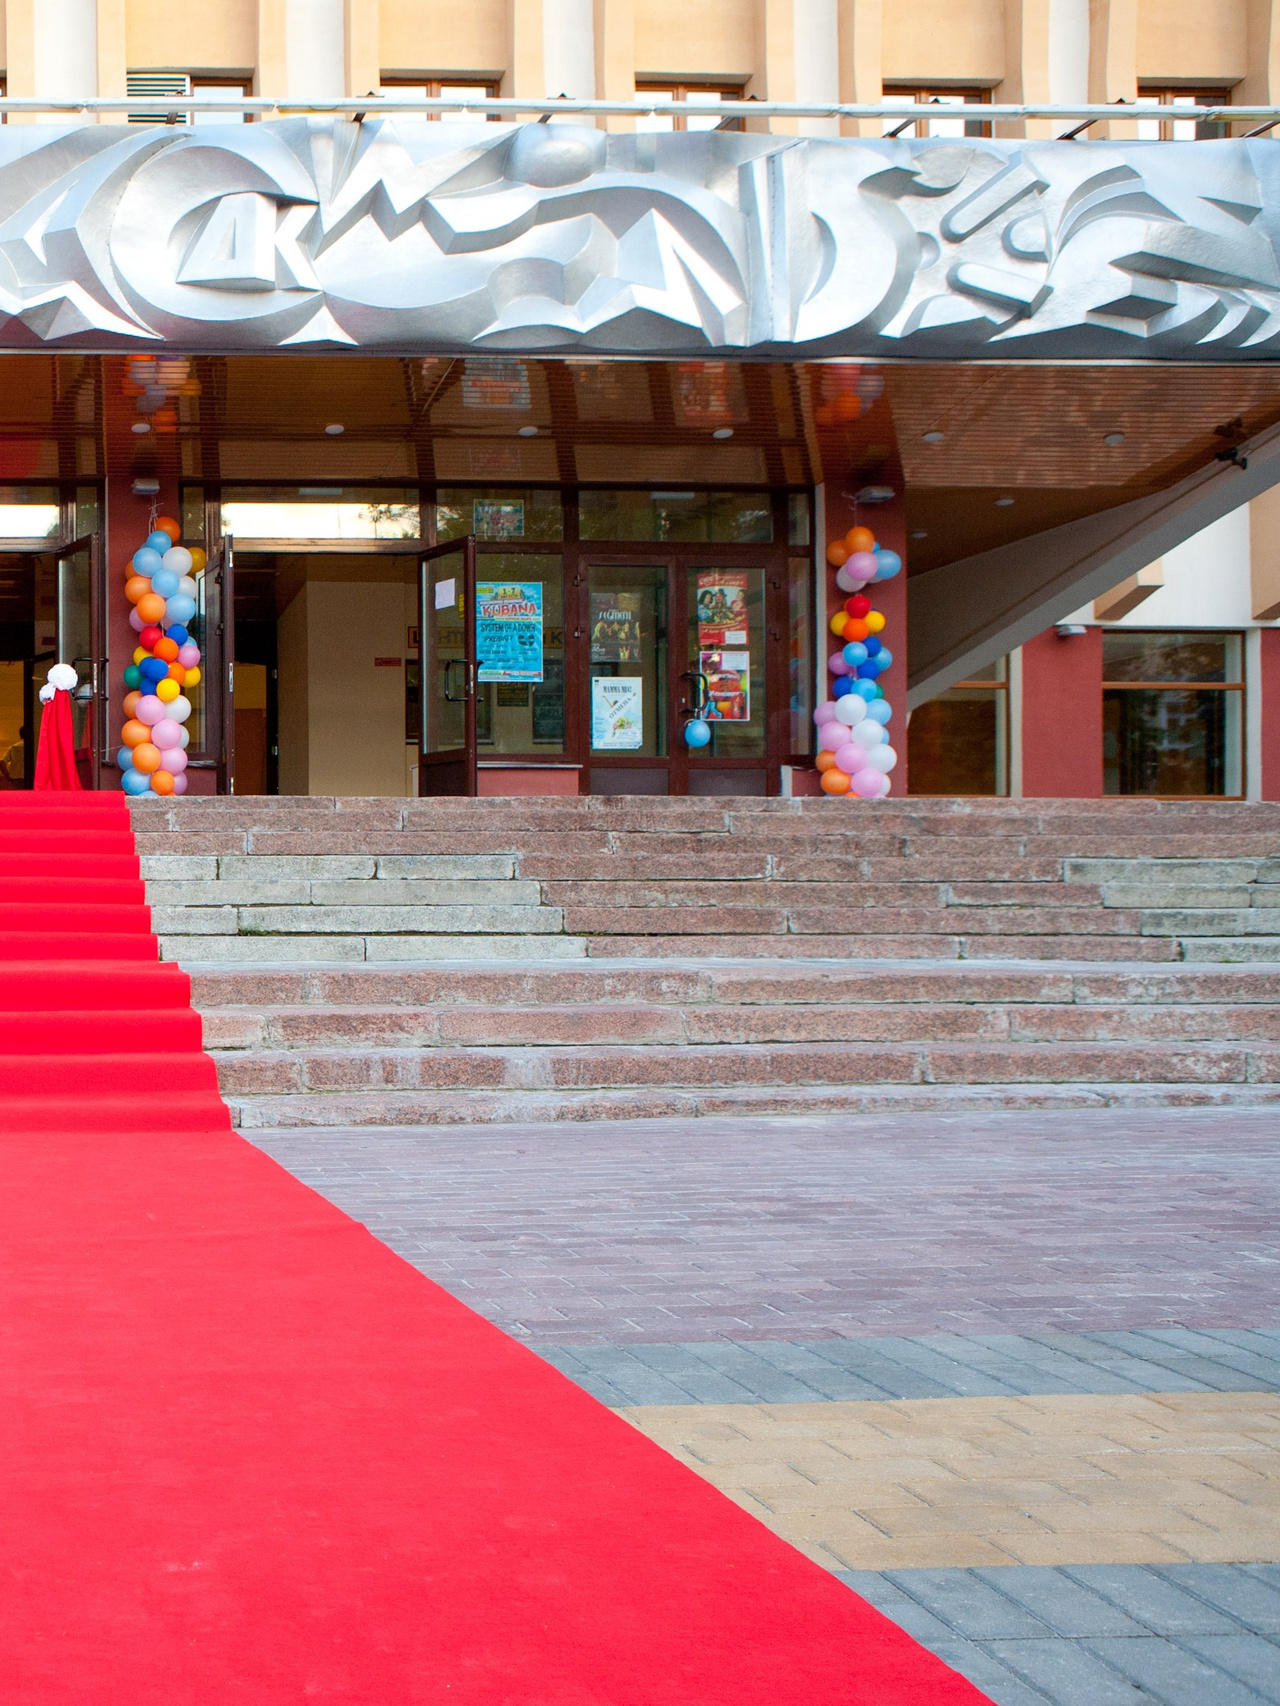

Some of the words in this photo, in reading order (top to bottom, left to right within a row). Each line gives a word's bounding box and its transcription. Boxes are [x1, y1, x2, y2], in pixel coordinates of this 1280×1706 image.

[482, 602, 537, 617] KUBANA
[481, 624, 504, 632] SYSTEM
[608, 697, 632, 720] ОТМЕНА
